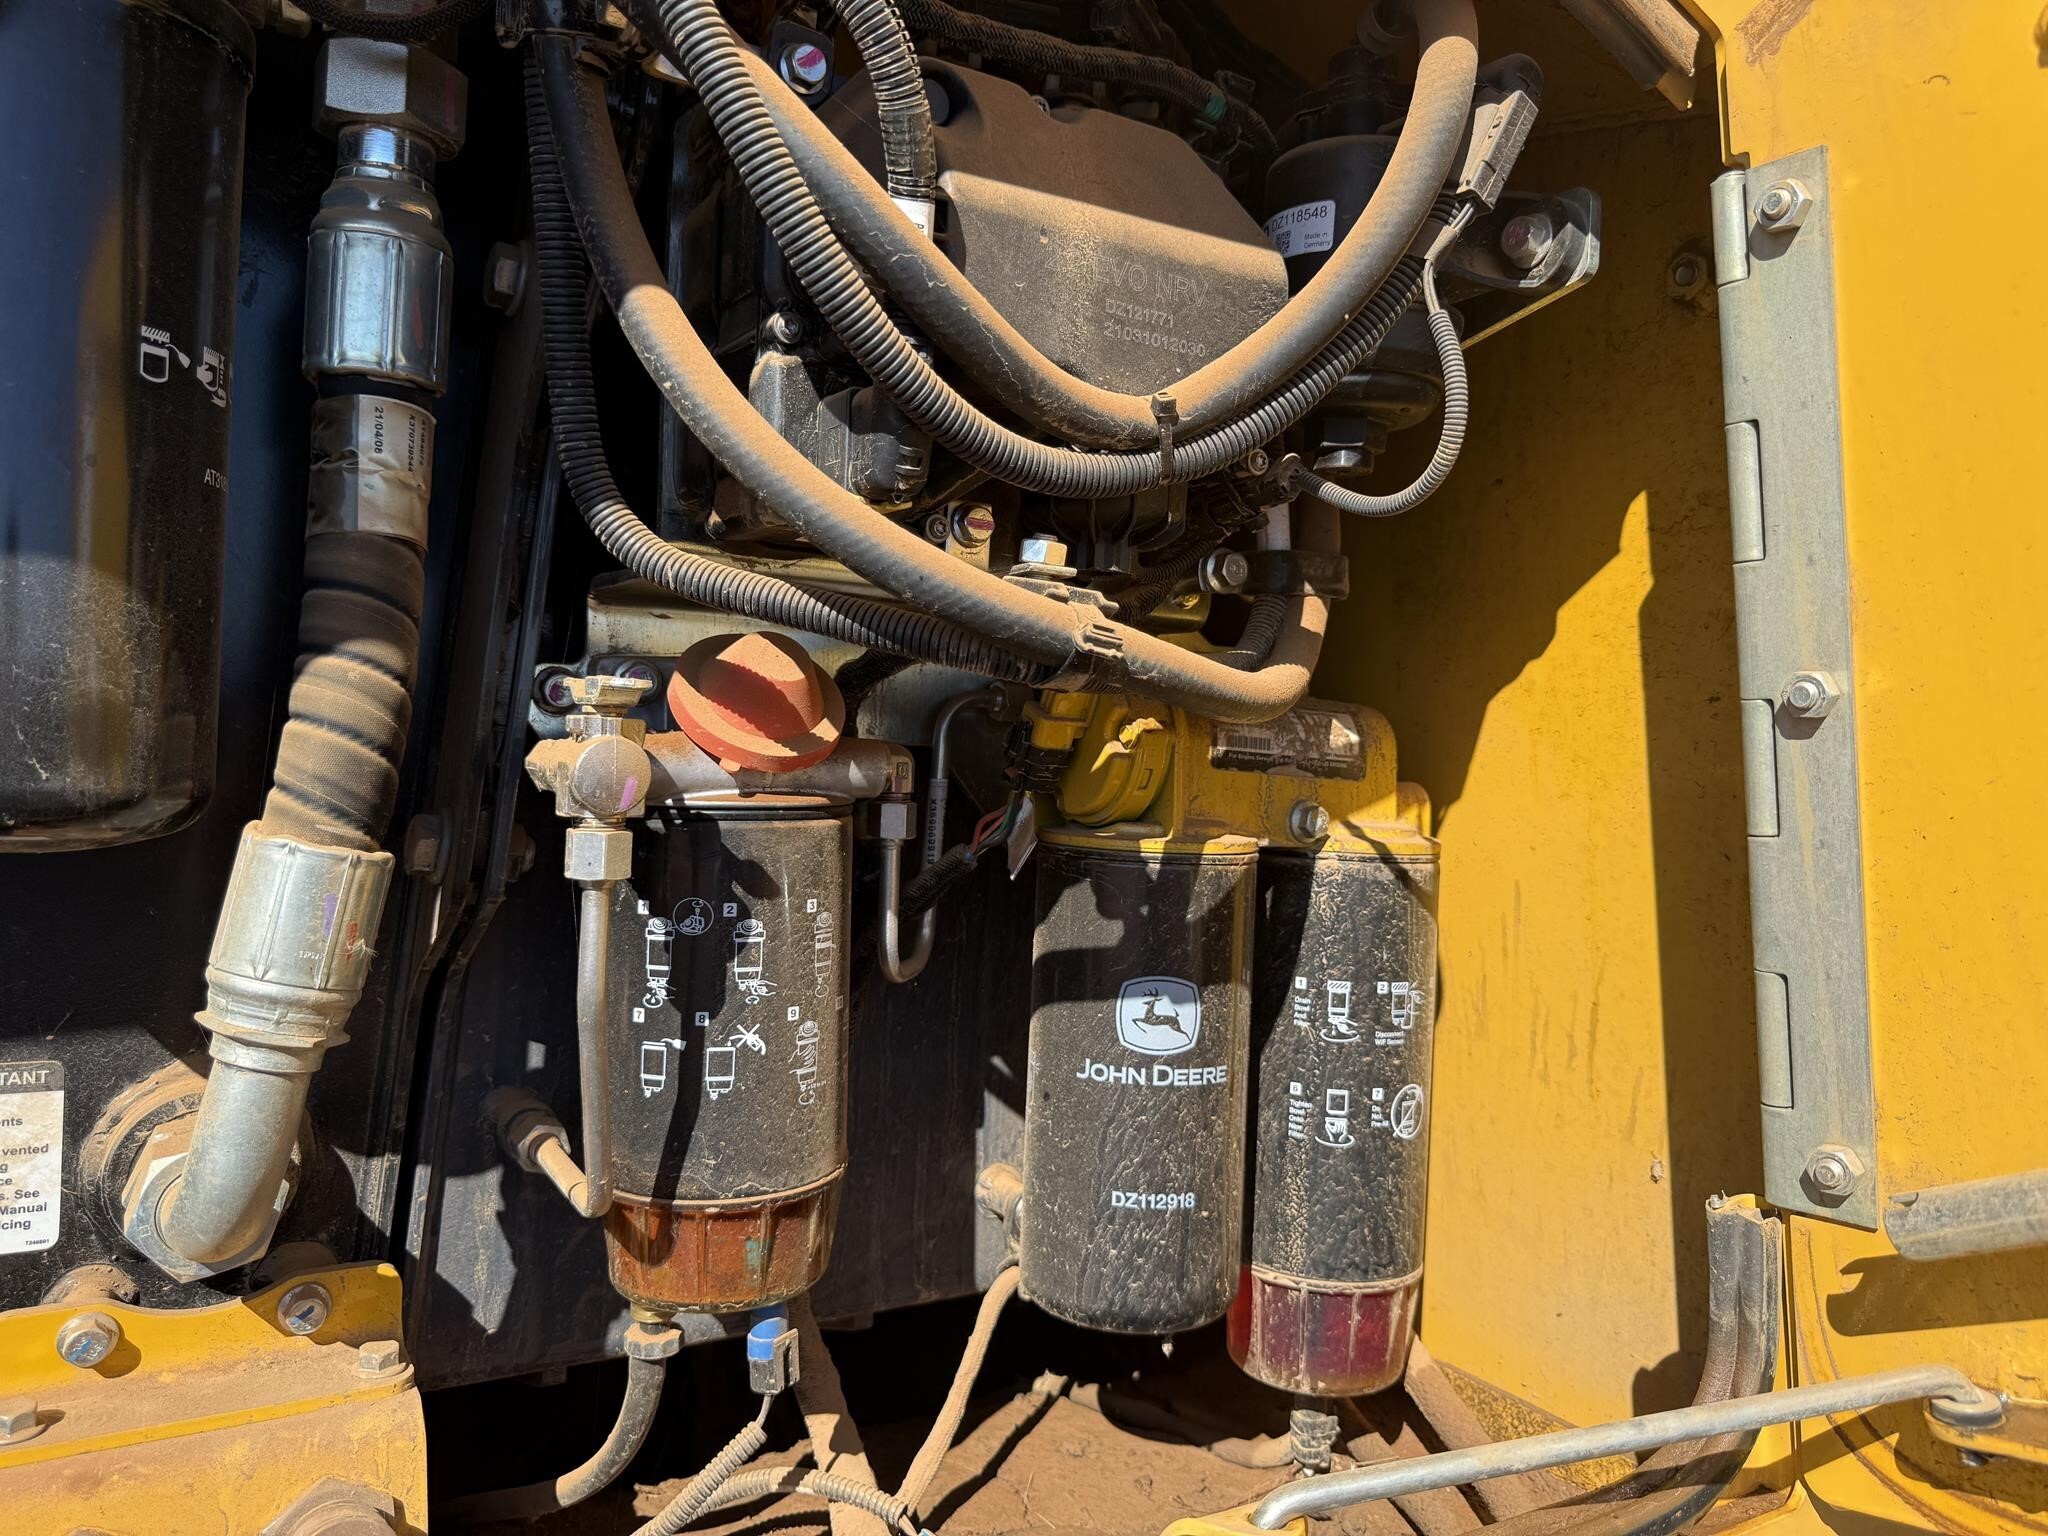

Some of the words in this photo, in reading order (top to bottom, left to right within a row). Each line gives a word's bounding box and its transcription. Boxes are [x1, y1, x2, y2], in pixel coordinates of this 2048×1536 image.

[1271, 205, 1328, 232] DZ118548
[1304, 240, 1331, 249] Germany
[1093, 253, 1148, 292] EVO
[374, 405, 385, 455] 21/04/08
[1076, 1058, 1146, 1085] JOHN
[1153, 1064, 1228, 1086] DEERE
[14, 1189, 40, 1200] See
[1111, 1190, 1195, 1210] DZ112918
